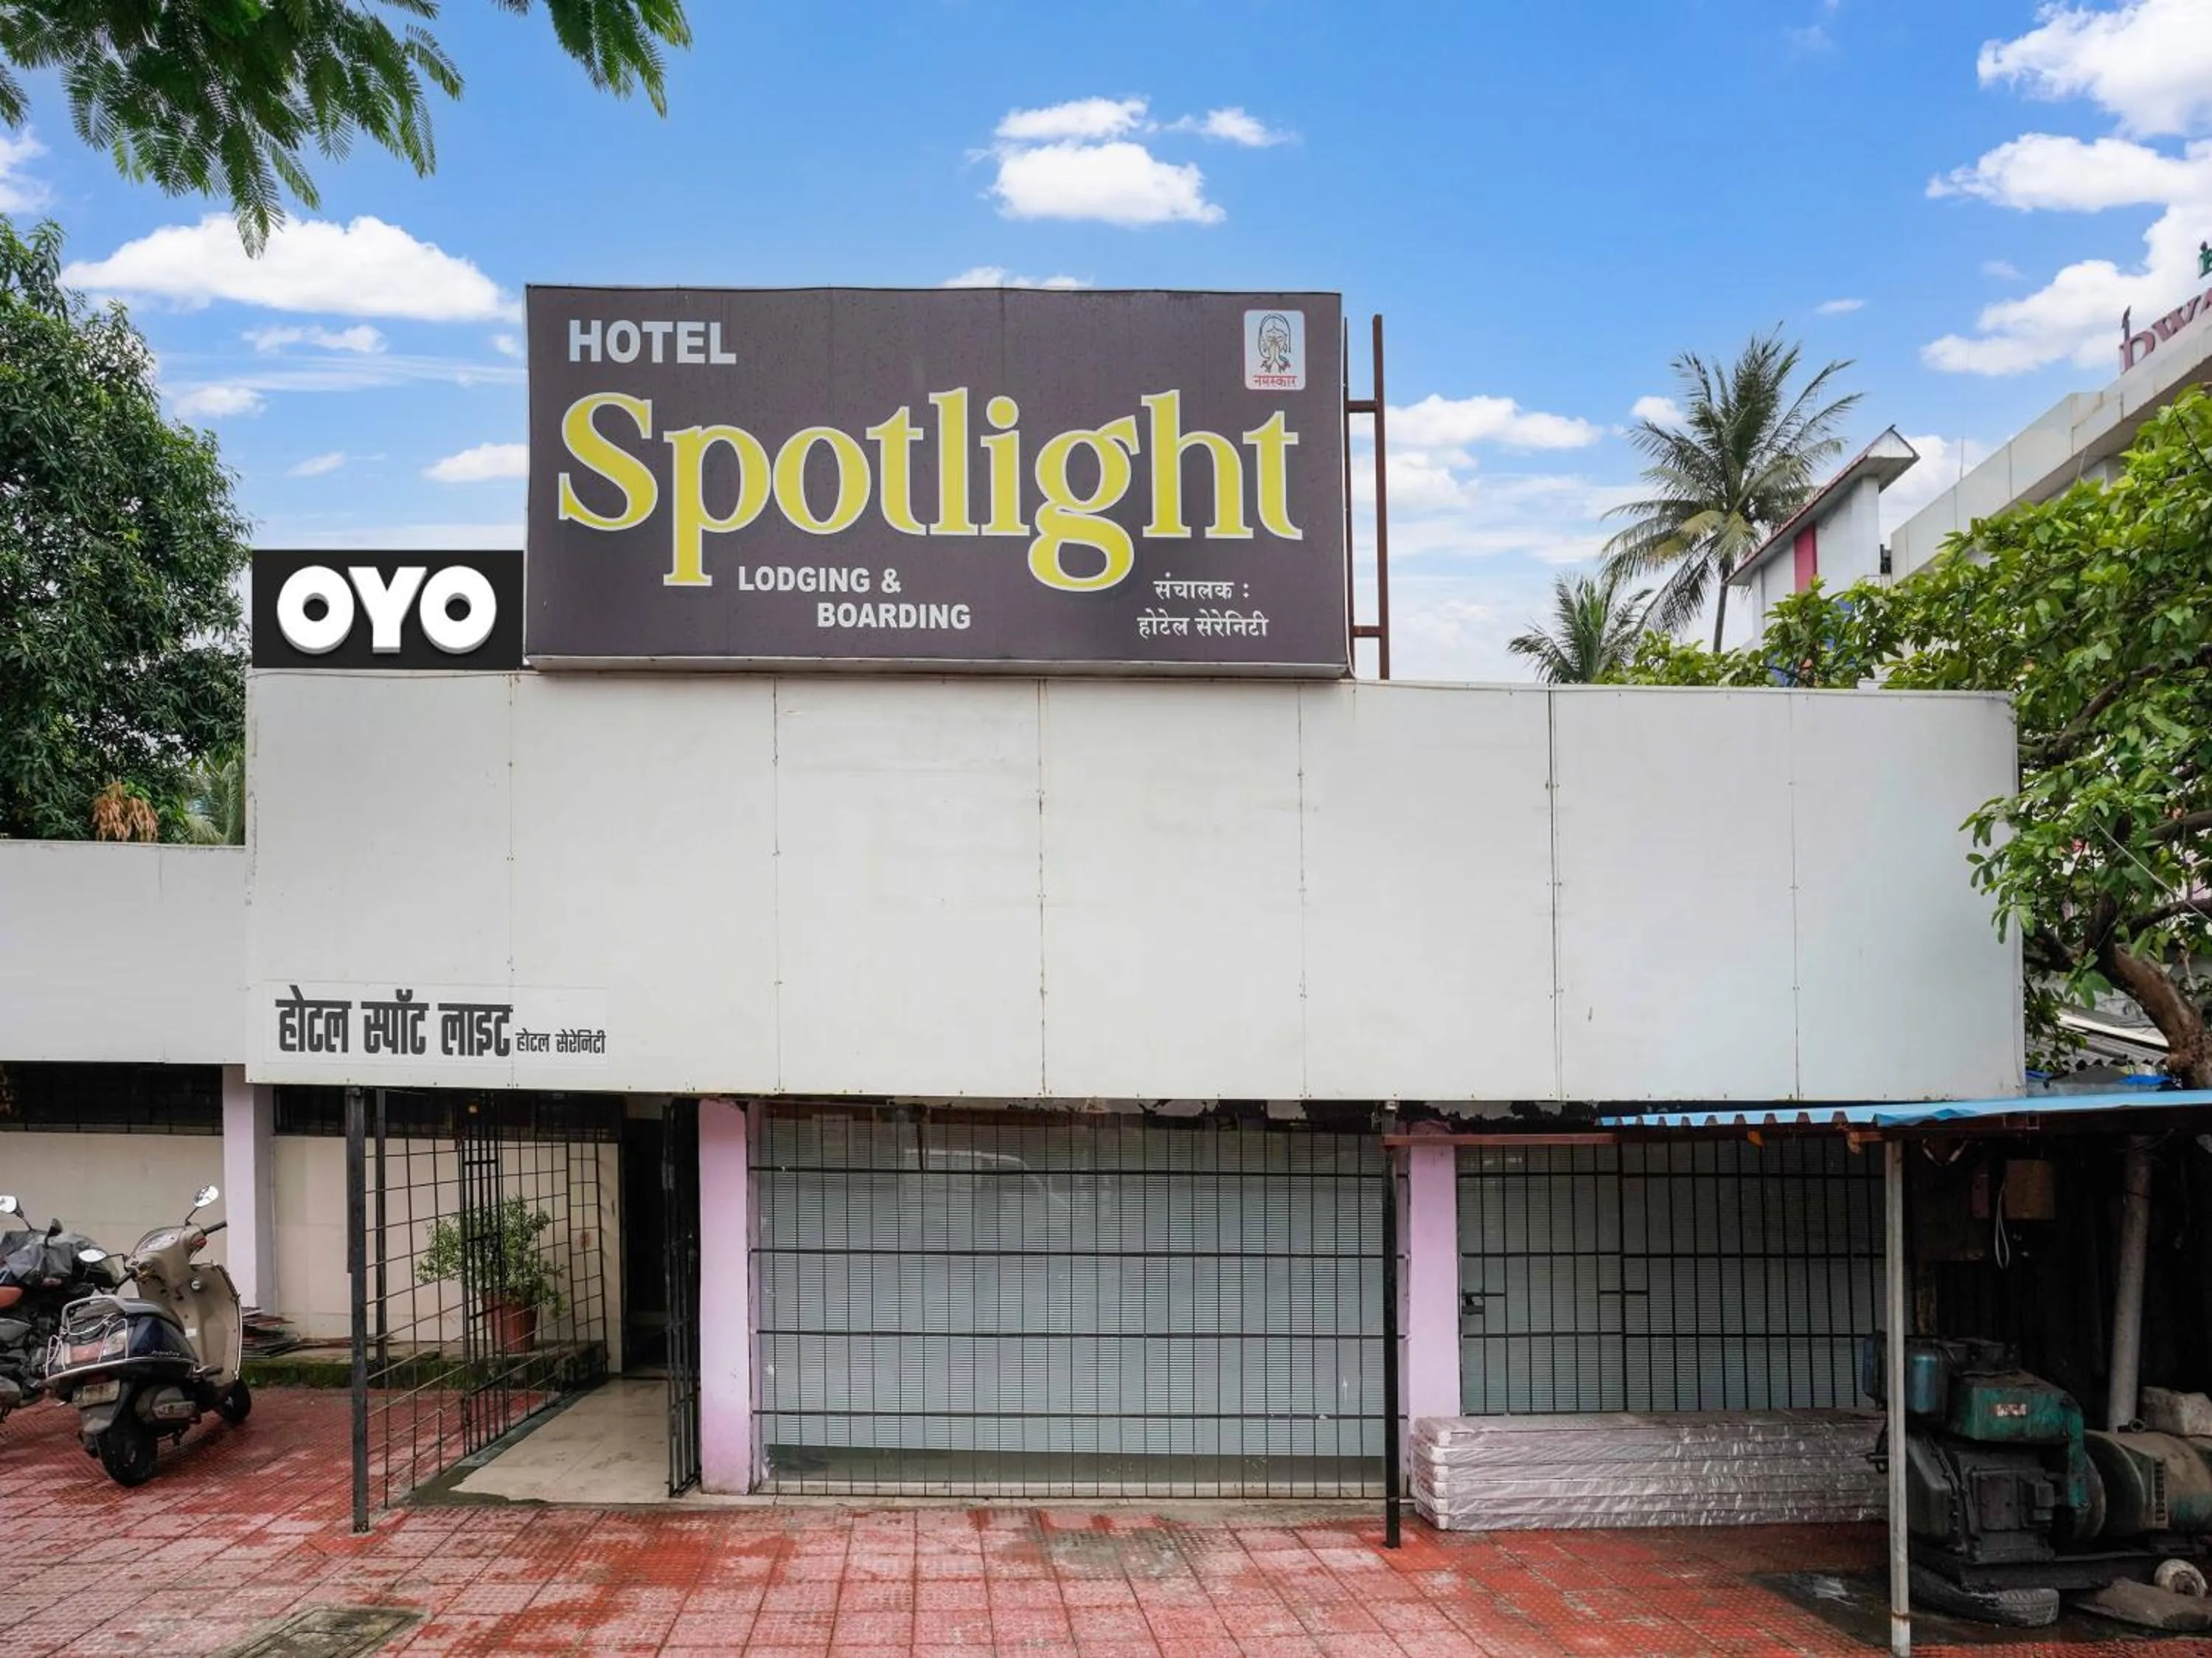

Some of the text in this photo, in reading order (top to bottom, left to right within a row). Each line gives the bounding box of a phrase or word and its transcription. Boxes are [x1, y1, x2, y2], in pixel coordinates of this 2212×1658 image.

[568, 319, 737, 364] HOTEL
[1253, 374, 1298, 387] नमस्कार
[558, 386, 1304, 592] Spotlight
[738, 566, 901, 593] LODGING &
[1152, 572, 1235, 600] संचालक
[276, 565, 497, 654] OYO
[817, 603, 971, 628] BOARDING
[1136, 608, 1270, 639] होटेल सेरेनिटी
[275, 985, 513, 1057] होटल स्पॉट लाइट
[515, 1027, 606, 1054] होटल सेरेनिटी
